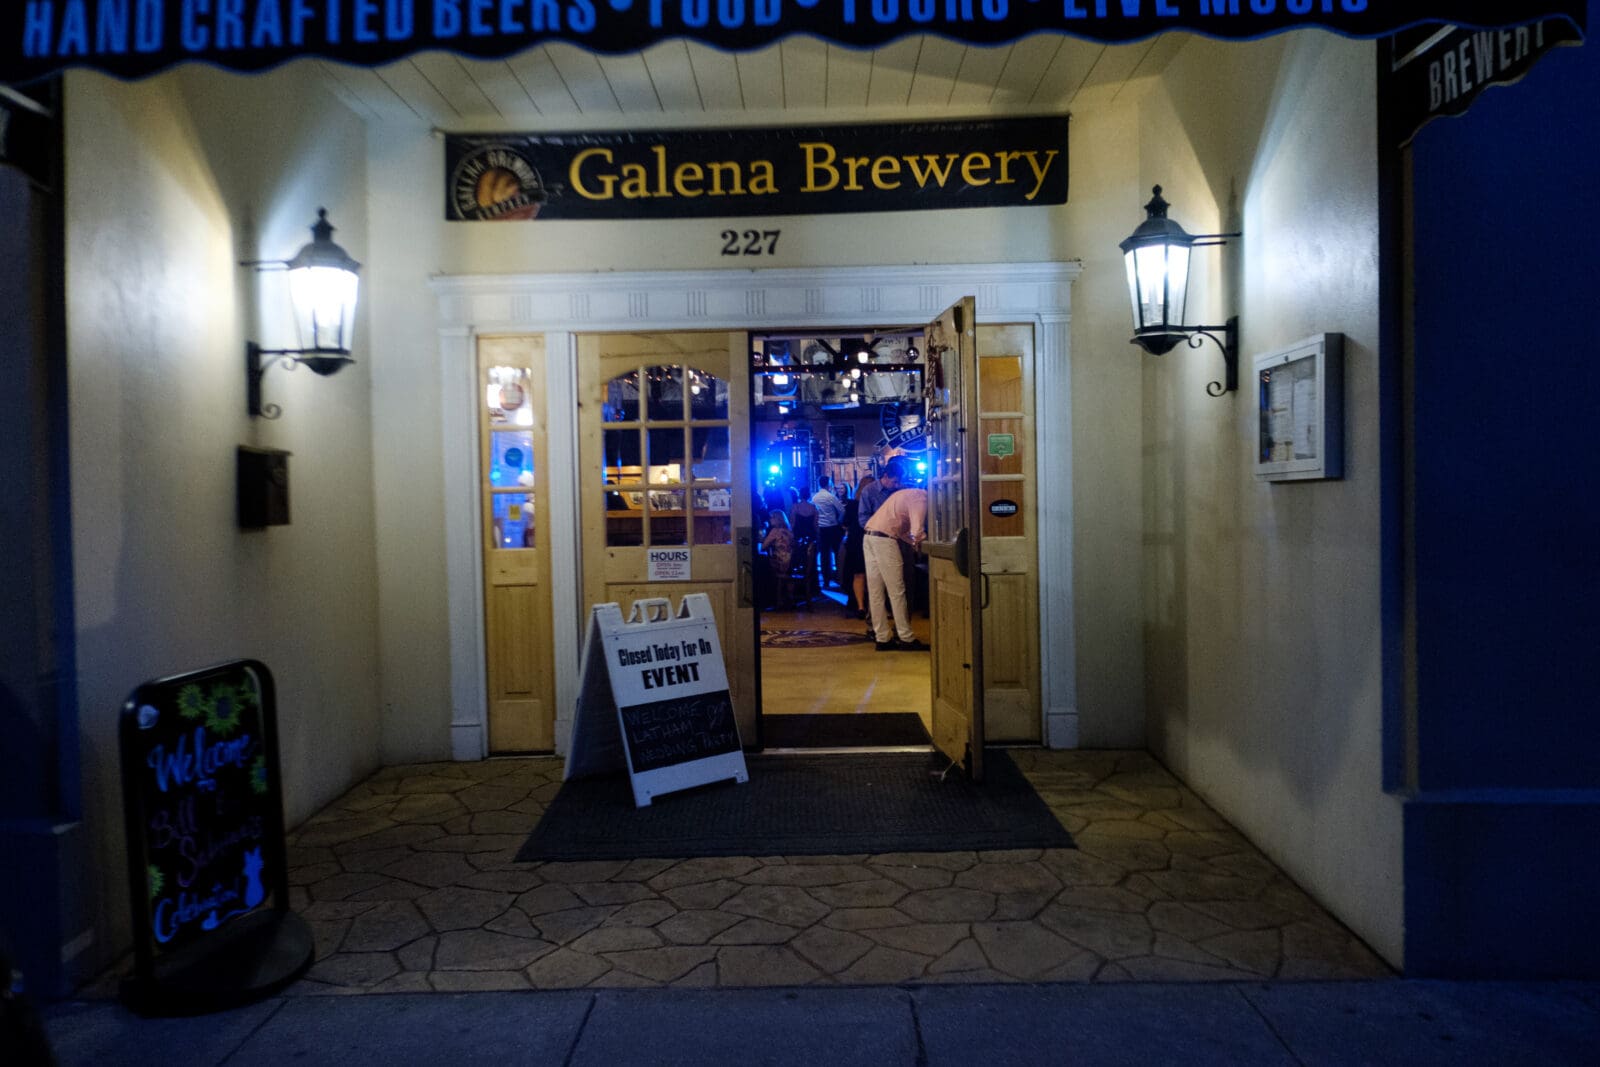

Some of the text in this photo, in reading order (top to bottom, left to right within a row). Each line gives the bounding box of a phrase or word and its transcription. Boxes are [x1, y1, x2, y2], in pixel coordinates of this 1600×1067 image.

[22, 0, 165, 57] HAND
[180, 0, 415, 50] CRAFTED
[569, 143, 1059, 201] Galena Brewery
[720, 229, 781, 256] 227
[650, 551, 689, 561] HOURS
[618, 638, 713, 667] Closed Today For An
[641, 662, 700, 690] EVENT
[625, 701, 701, 725] WELCOME
[147, 725, 256, 792] Welcome
